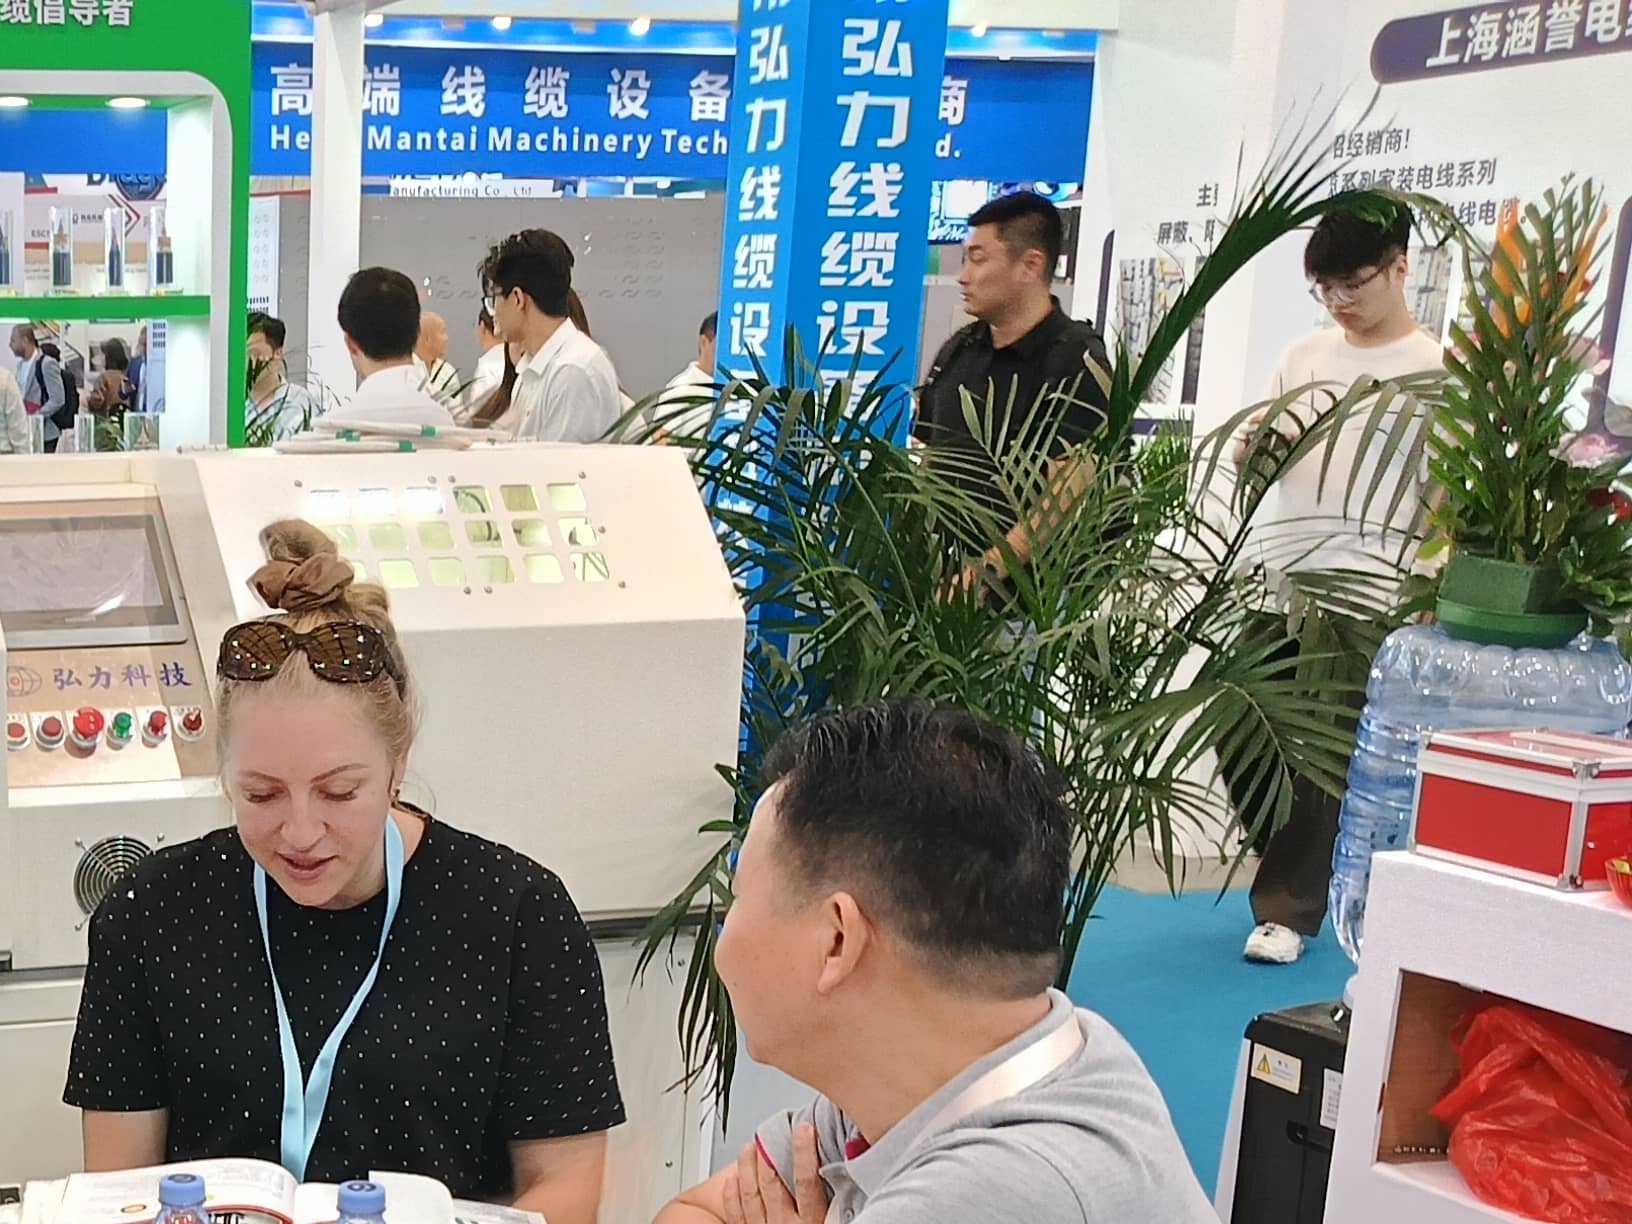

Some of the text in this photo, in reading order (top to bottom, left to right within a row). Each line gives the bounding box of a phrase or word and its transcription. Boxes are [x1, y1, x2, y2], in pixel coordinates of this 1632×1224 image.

[1425, 0, 1632, 68] 上海涵誉电
[270, 126, 963, 159] He Mantai Machinery Tech d.
[718, 0, 790, 421] 弘力线缆设
[1196, 183, 1219, 207] 主
[52, 661, 192, 690] 弘力科技
